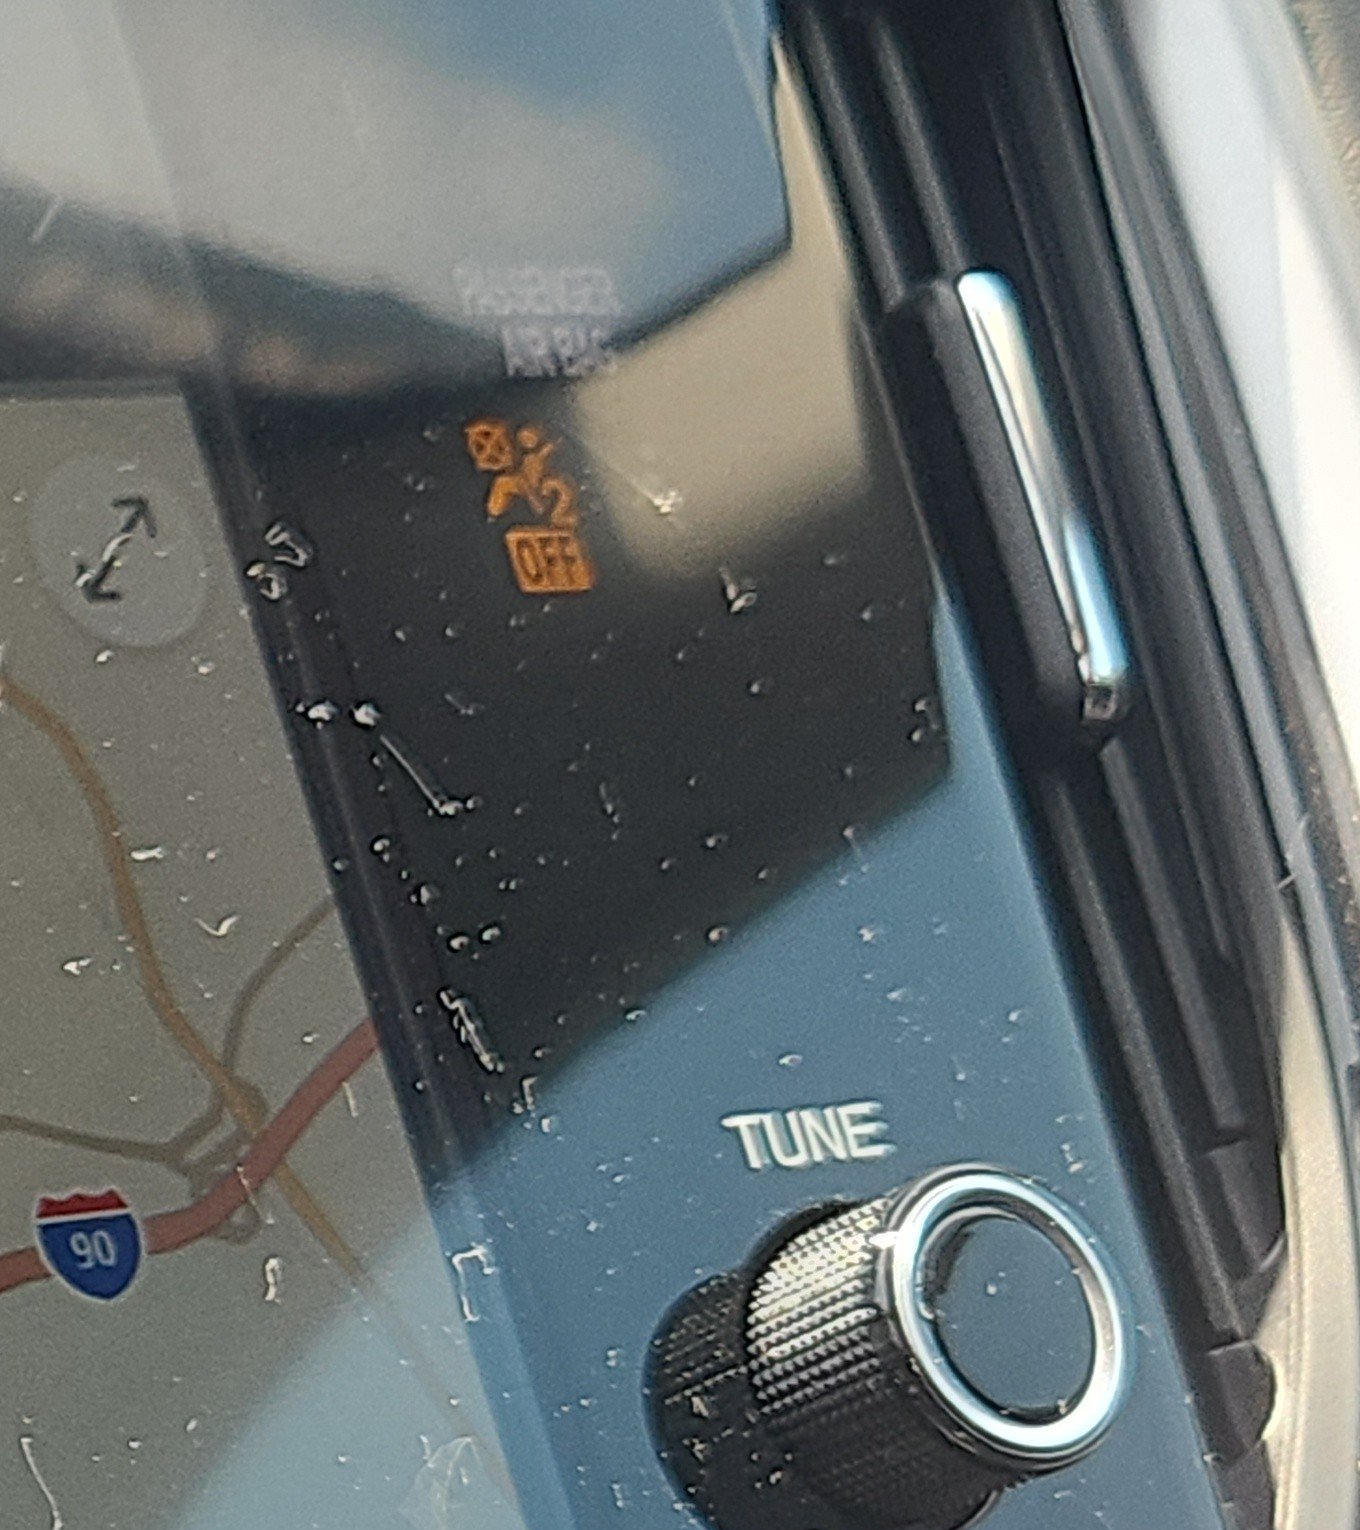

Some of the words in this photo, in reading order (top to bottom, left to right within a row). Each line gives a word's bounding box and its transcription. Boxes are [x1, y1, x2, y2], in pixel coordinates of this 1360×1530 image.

[514, 535, 592, 588] OFF
[721, 1100, 896, 1170] TUNE
[69, 1226, 118, 1270] 90
